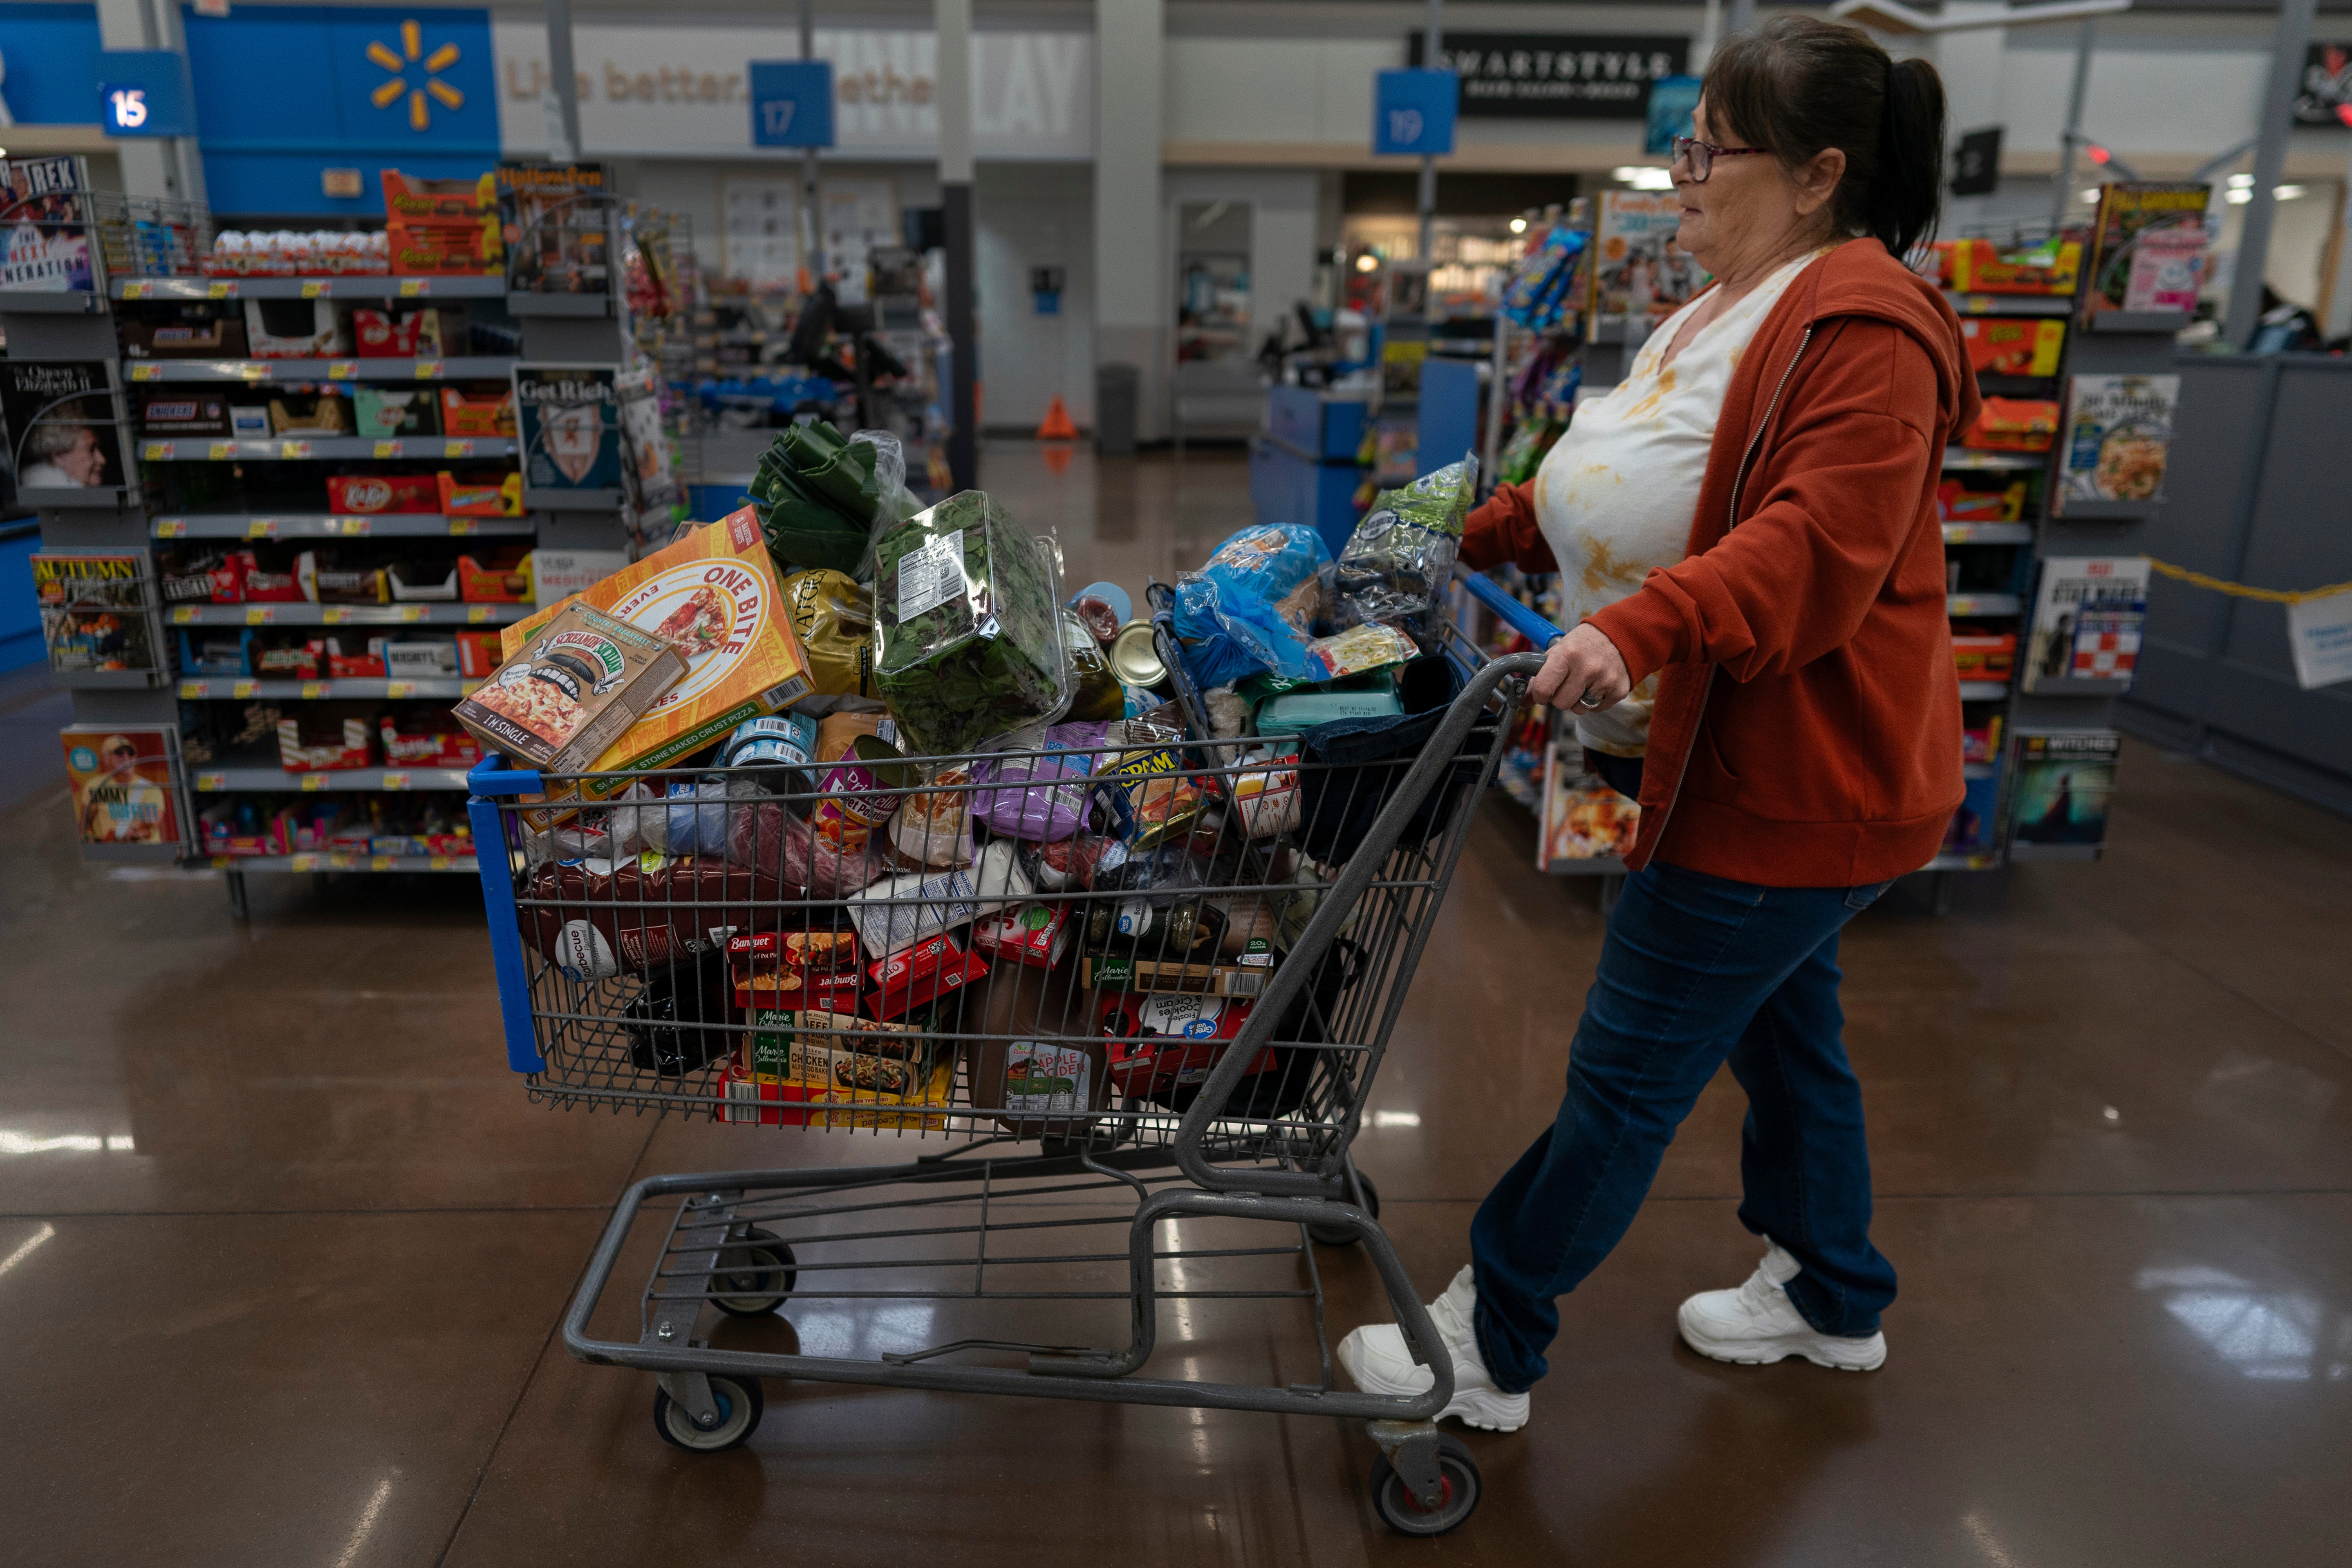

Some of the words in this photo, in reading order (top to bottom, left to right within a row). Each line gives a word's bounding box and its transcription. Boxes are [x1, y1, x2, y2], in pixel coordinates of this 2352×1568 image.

[111, 90, 147, 127] 15
[763, 101, 795, 135] 17
[1388, 108, 1423, 145] 19
[12, 159, 74, 194] TREK
[19, 232, 35, 243] THE
[10, 242, 47, 264] NEXT
[3, 257, 83, 283] NERATION
[28, 365, 72, 380] Queen
[734, 525, 745, 545] SPORTS
[741, 520, 754, 546] BARSTOOL
[34, 559, 133, 580] AUTUMN
[703, 567, 753, 597] ONE
[583, 611, 614, 628] COUNTRY
[613, 625, 652, 646] BREAKFAST
[721, 595, 758, 655] BITE
[553, 632, 605, 649] SCREAMIN'
[594, 641, 624, 674] SICILIAN
[504, 668, 531, 677] Breakfast
[483, 715, 497, 728] I'M
[495, 721, 530, 745] SINGLE
[639, 750, 670, 768] STONE
[668, 735, 699, 754] BAKED
[699, 719, 728, 738] CRUST
[729, 706, 755, 724] PIZZA
[553, 748, 571, 766] Nutrition
[556, 757, 569, 770] Facts
[576, 760, 586, 769] 680
[1119, 751, 1176, 788] SPAM
[847, 770, 899, 809] Priella
[857, 803, 890, 822] Poatoes
[959, 871, 973, 896] Nutrition
[955, 904, 965, 916] 110
[579, 930, 591, 951] Flavored
[623, 932, 632, 950] Quality.
[731, 937, 770, 950] Banuet
[571, 930, 594, 978] Barbecue
[907, 948, 929, 960] stwberry
[819, 974, 857, 986] Banqet
[1098, 966, 1129, 976] Marie
[1154, 994, 1176, 1002] astries
[1196, 995, 1202, 1003] &
[759, 1010, 791, 1021] Maie
[813, 1013, 830, 1021] ROASTED
[1158, 1004, 1201, 1017] Cookes
[1167, 1012, 1196, 1021] Froste
[755, 1045, 785, 1056] Mare
[806, 1037, 826, 1046] BOWL
[755, 1055, 788, 1063] Callendr's
[791, 1053, 829, 1068] CHCKEN
[1038, 1053, 1077, 1068] APPLE
